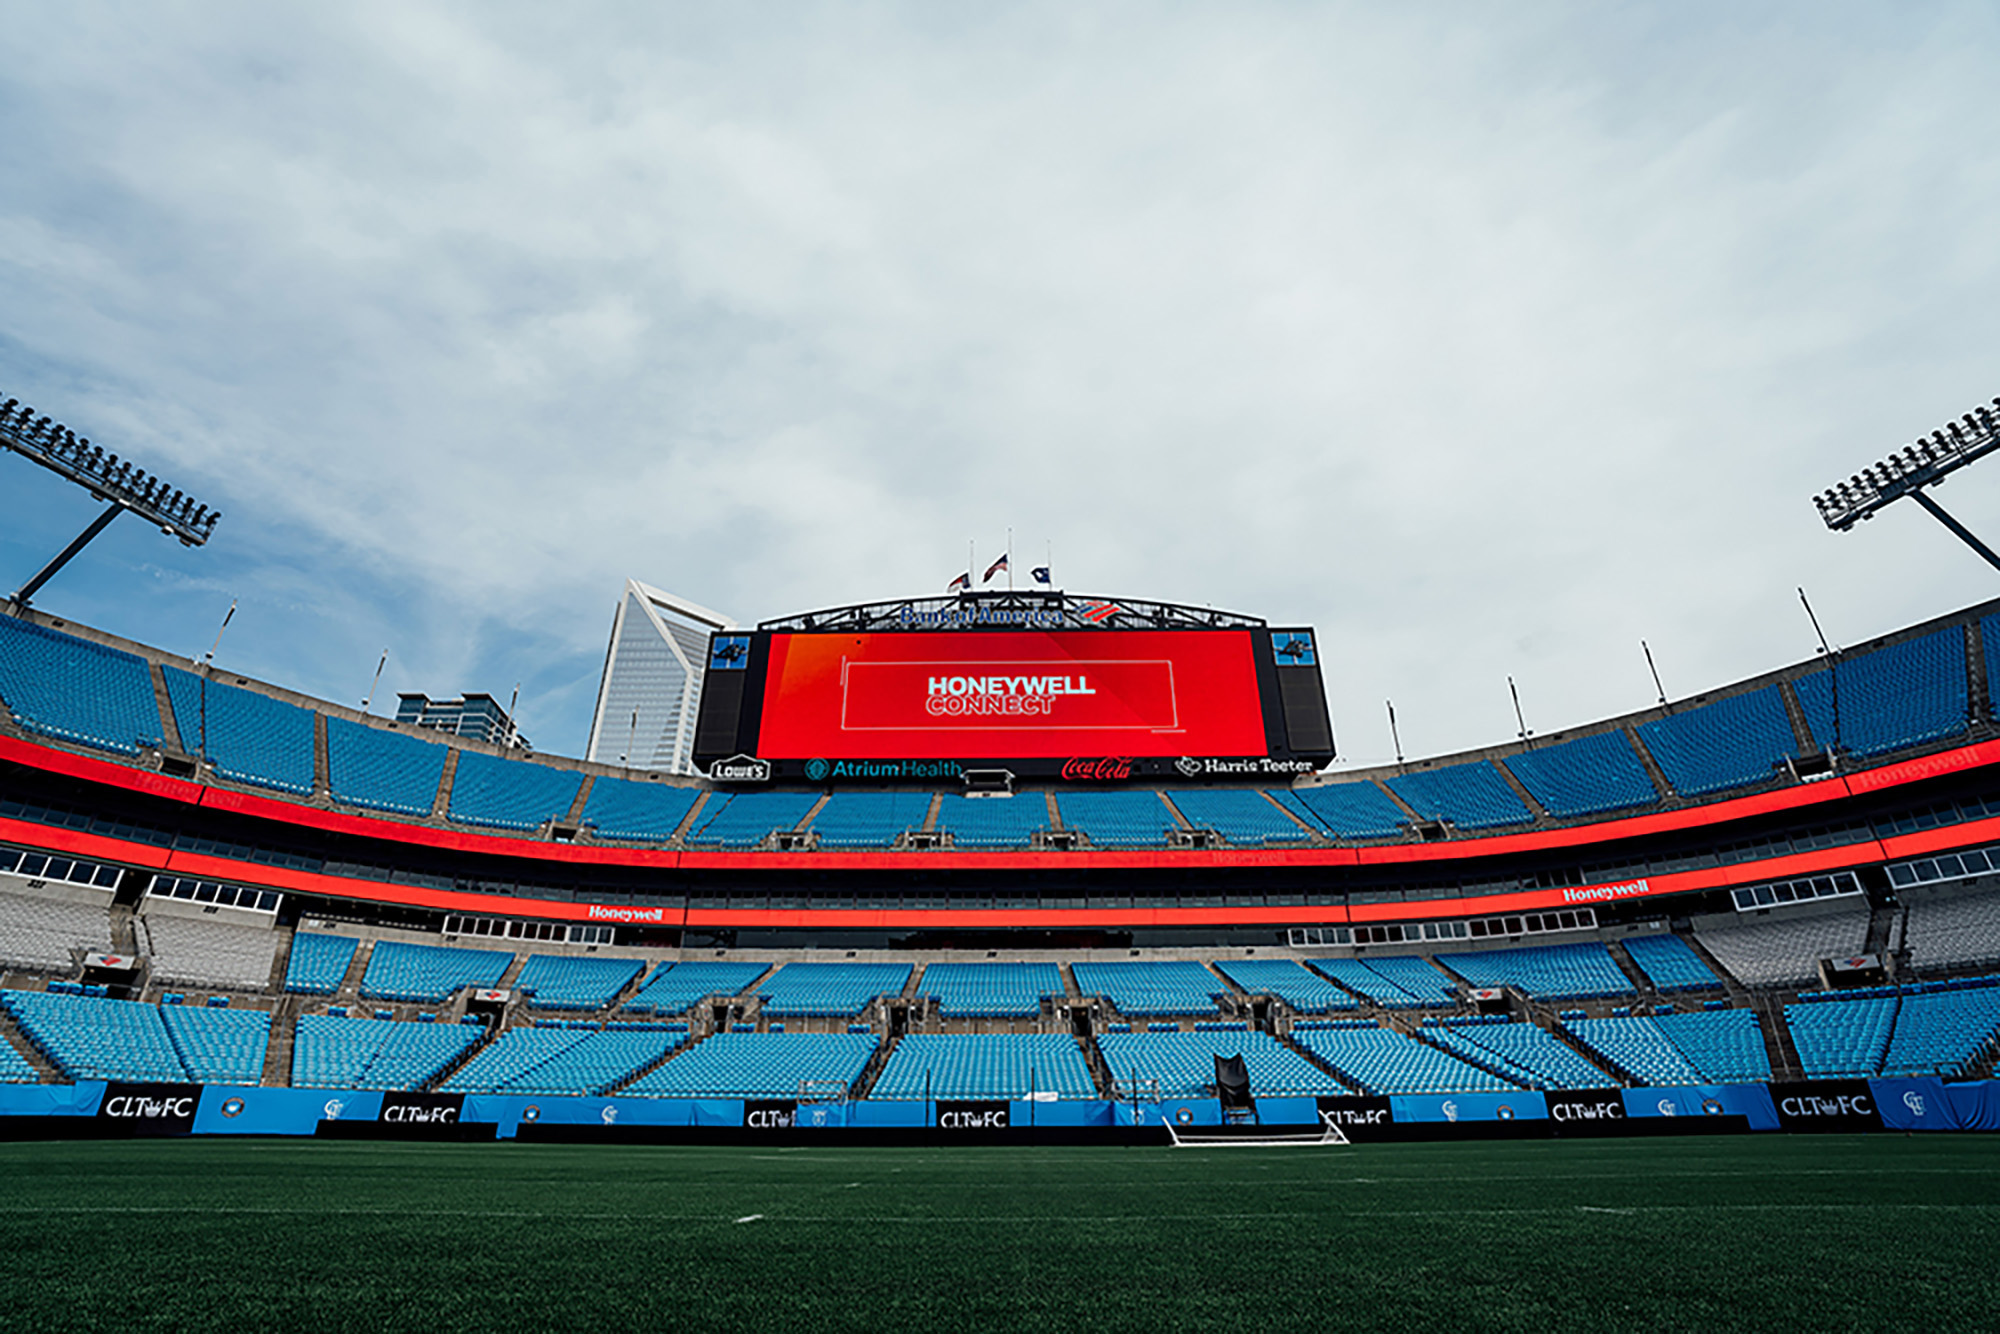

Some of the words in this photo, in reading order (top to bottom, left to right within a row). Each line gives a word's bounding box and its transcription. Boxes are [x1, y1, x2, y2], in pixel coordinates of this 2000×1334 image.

[899, 606, 949, 625] Bank
[954, 606, 975, 625] of
[977, 605, 1064, 625] America
[927, 675, 1096, 695] HONEYWELL
[925, 693, 1057, 716] CONNECT
[1204, 759, 1257, 773] Harris
[1259, 758, 1313, 773] Teeter
[1562, 879, 1649, 901] Honeywell
[588, 905, 663, 922] Honeywell
